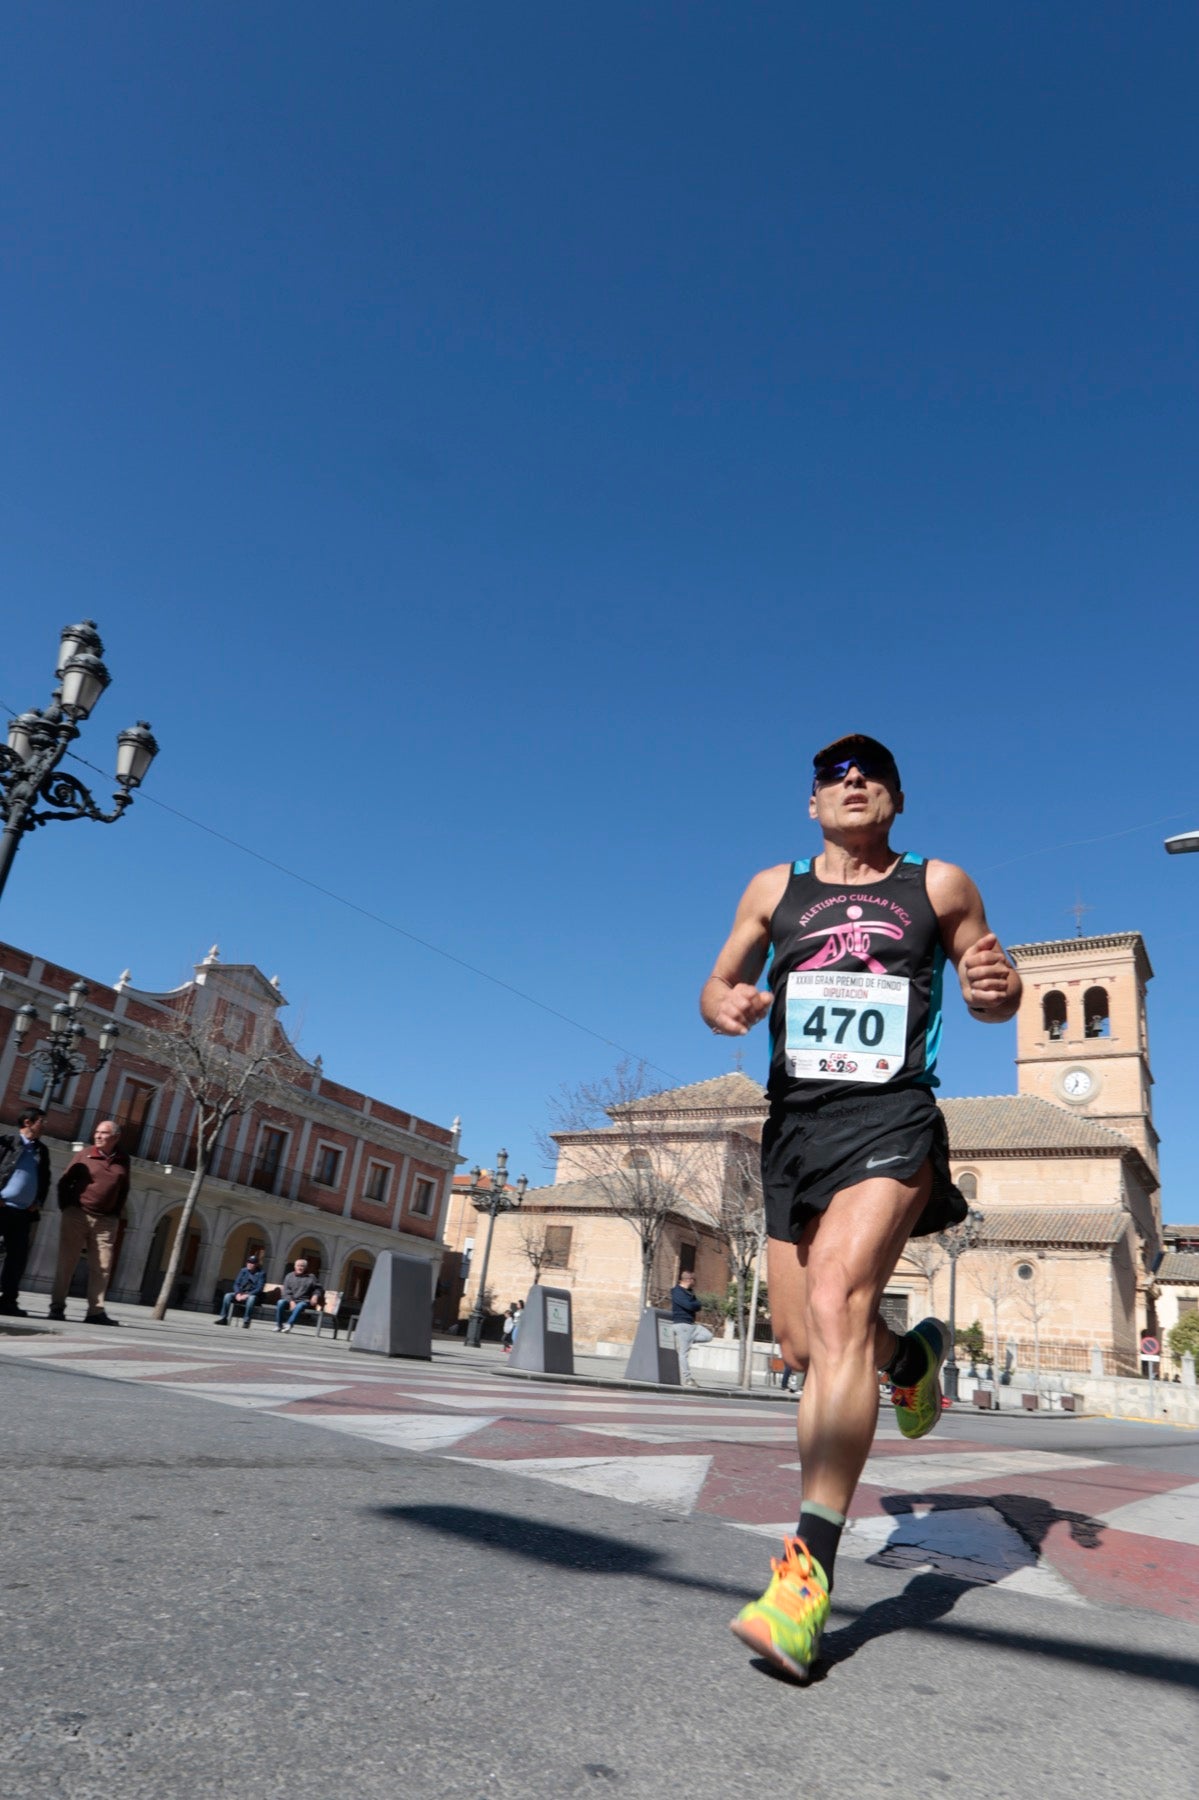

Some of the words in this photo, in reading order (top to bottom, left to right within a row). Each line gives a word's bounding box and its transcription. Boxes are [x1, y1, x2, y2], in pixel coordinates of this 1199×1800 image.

[799, 895, 847, 927] ATLETISMO
[849, 894, 888, 907] CULLAR
[889, 902, 912, 927] VEGA
[815, 976, 833, 985] GRAN
[836, 976, 864, 987] PREMIO
[866, 978, 875, 988] DE
[877, 978, 901, 991] FONDO
[803, 1006, 884, 1047] 470
